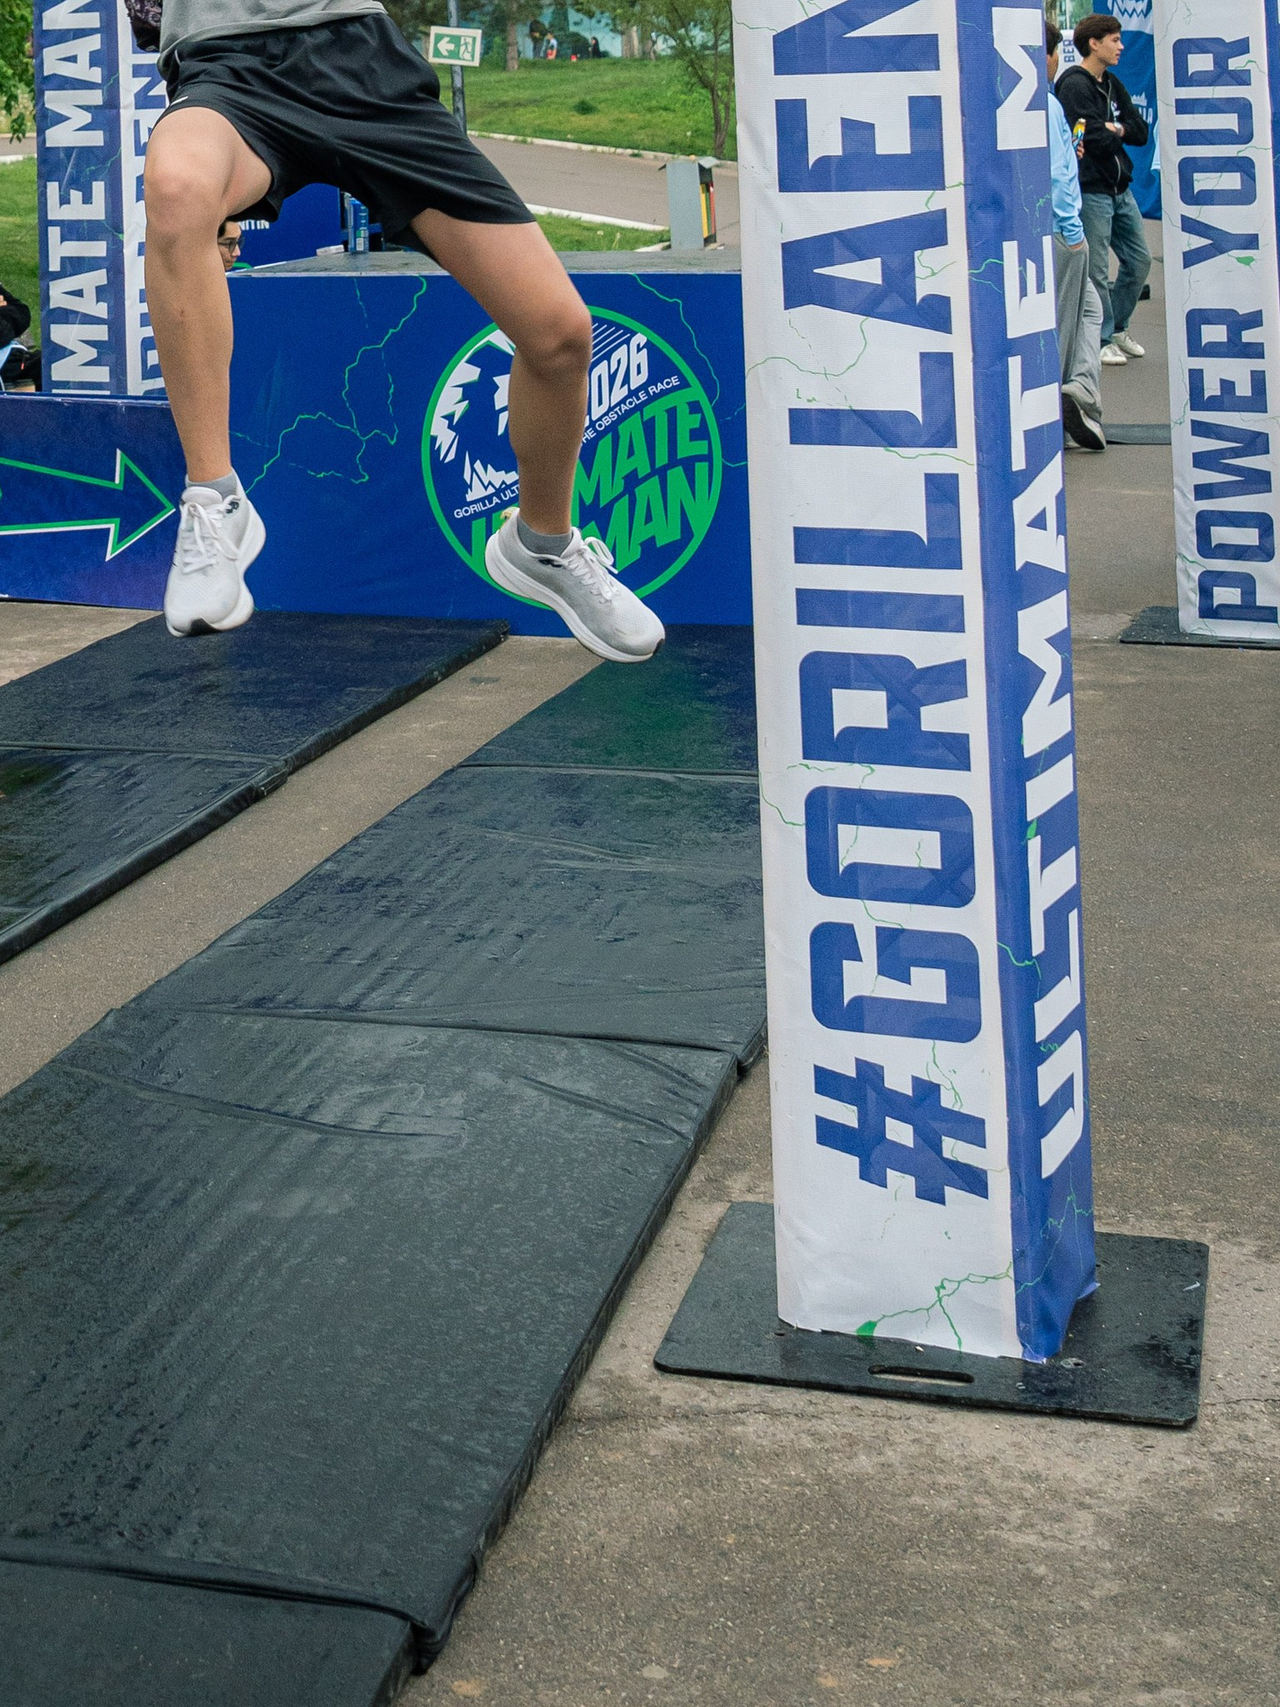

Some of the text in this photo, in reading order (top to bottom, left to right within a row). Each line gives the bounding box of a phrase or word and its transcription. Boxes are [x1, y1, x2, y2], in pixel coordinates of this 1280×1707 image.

[1173, 36, 1261, 270] YOUR
[46, 181, 111, 395] MATE
[585, 332, 649, 428] 026
[453, 496, 502, 519] GORILLA
[595, 390, 648, 432] OBSTACLE
[647, 375, 681, 397] RACE
[581, 461, 710, 573] MAN
[1186, 305, 1280, 622] POWER
[1004, 236, 1086, 1179] ULTIMATE
